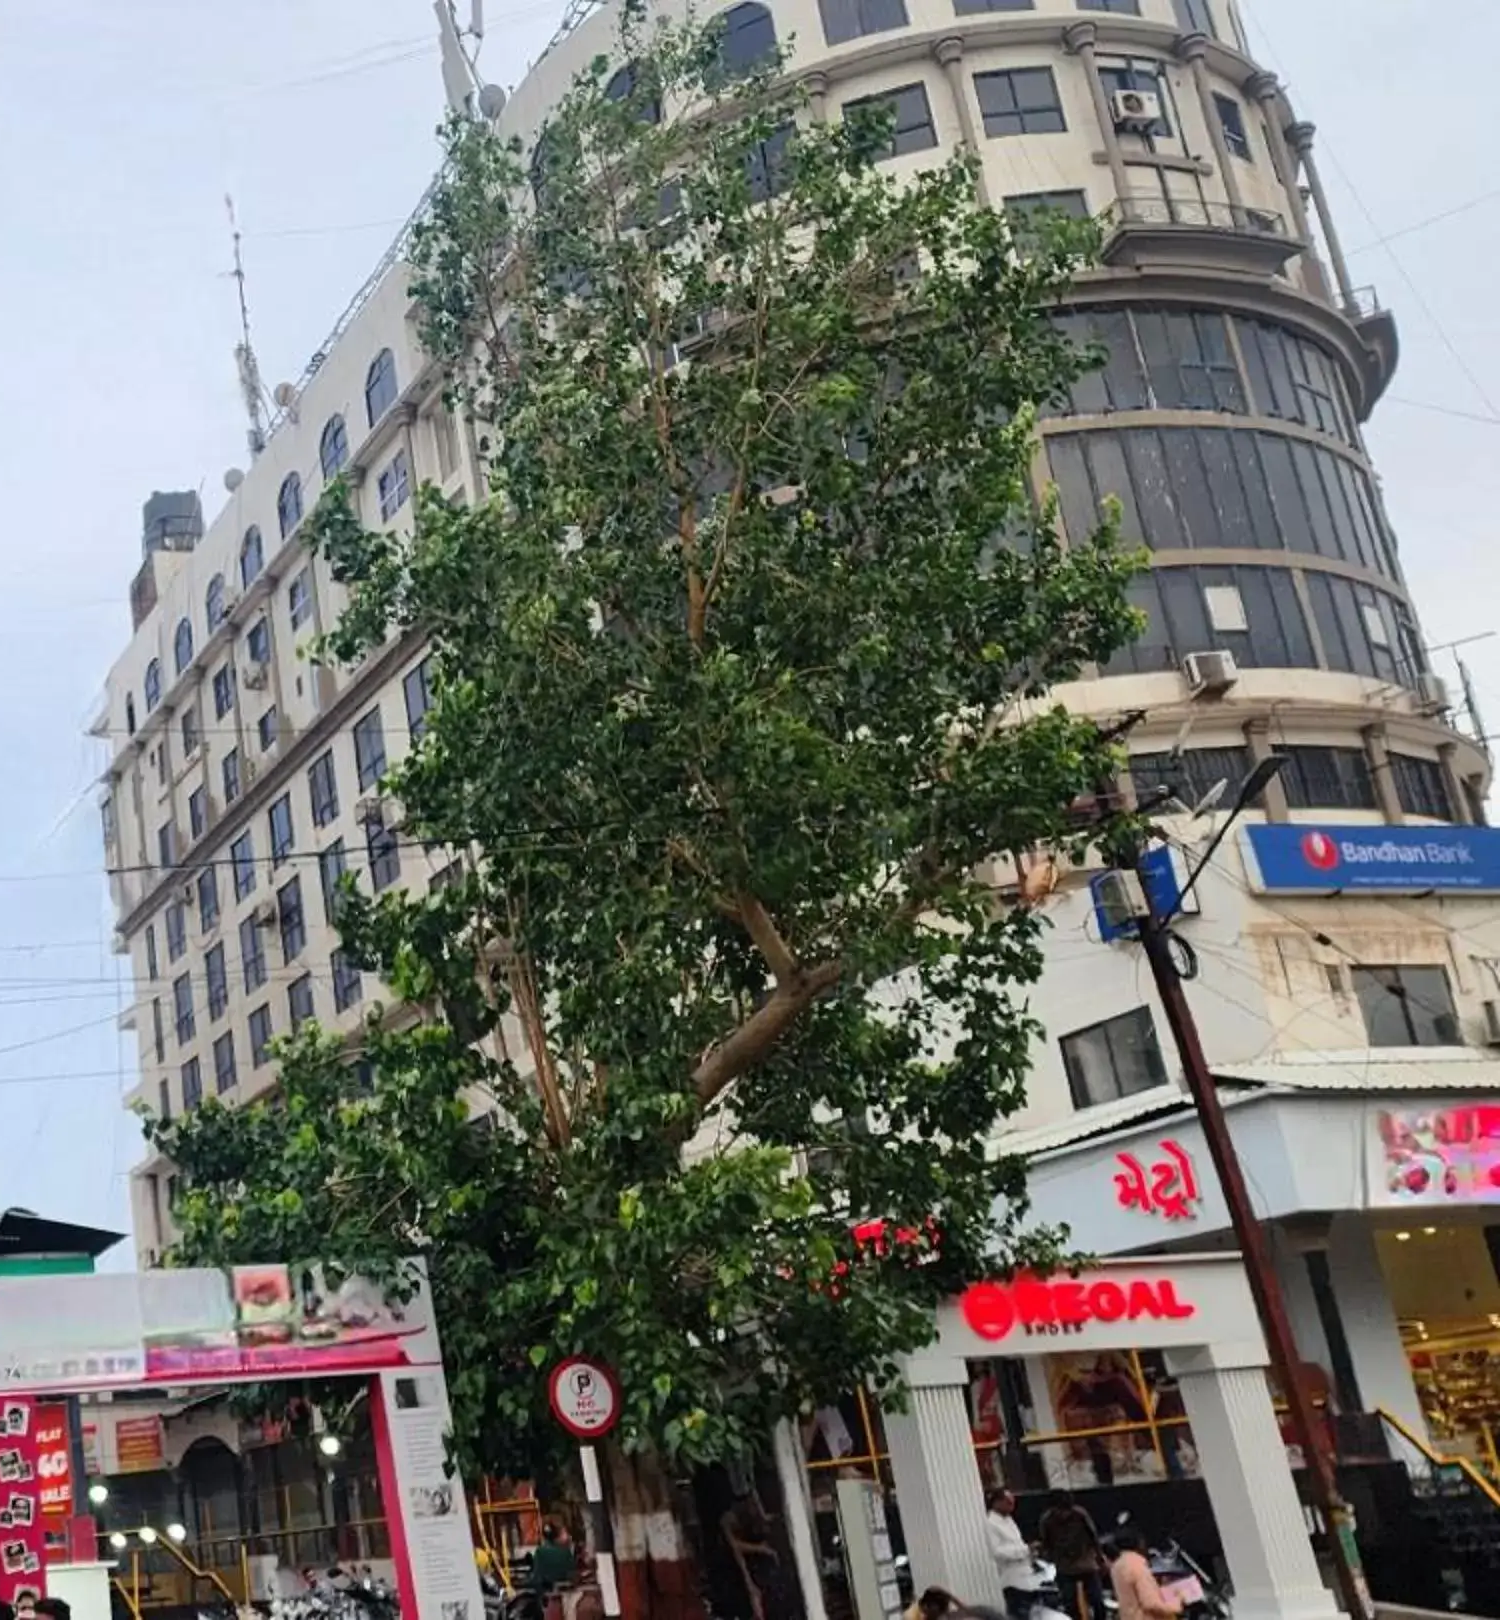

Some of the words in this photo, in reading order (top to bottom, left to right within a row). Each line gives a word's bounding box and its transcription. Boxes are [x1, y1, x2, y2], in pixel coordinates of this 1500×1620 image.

[1341, 840, 1426, 862] Bandhan
[1425, 840, 1475, 864] Bank
[1013, 1275, 1195, 1322] REGAL
[36, 1427, 62, 1443] FLAT
